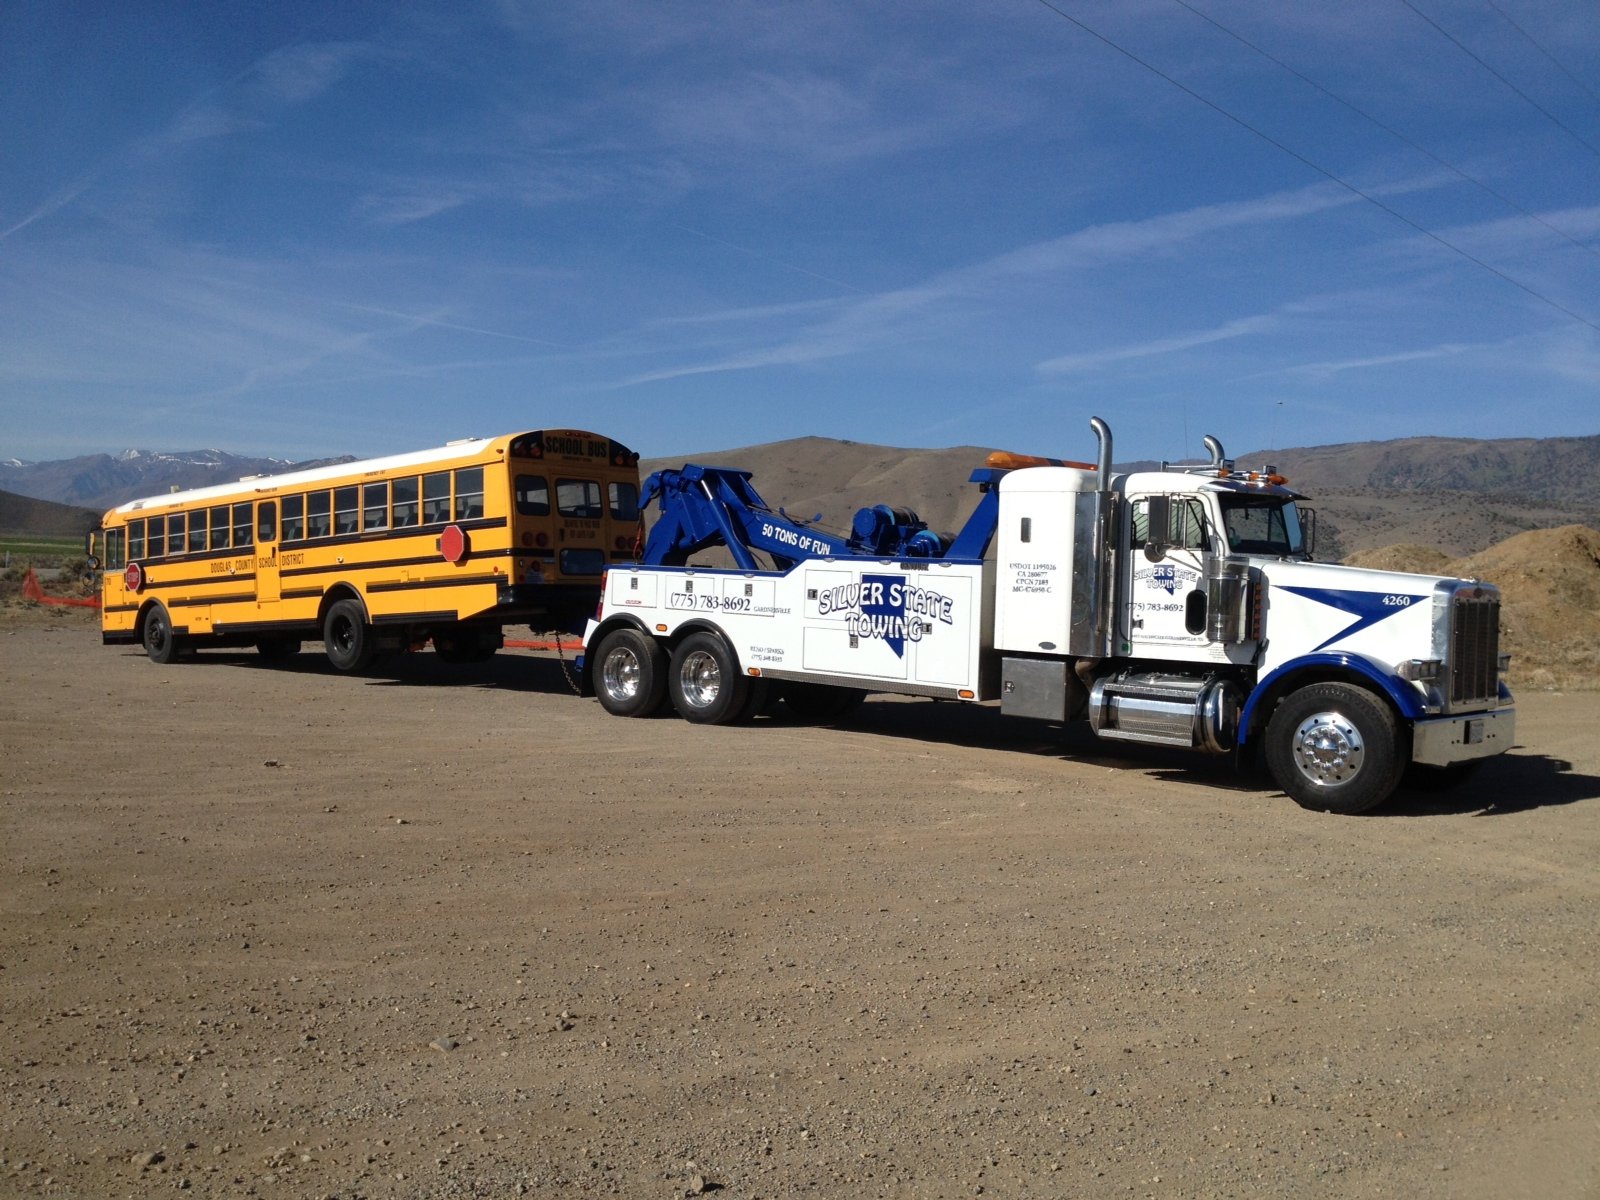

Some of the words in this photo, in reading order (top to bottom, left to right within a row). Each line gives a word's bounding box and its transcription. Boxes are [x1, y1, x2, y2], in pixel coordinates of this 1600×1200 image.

[545, 436, 584, 455] SCHOOL
[588, 440, 607, 458] BUS
[762, 524, 773, 536] 50
[775, 526, 798, 546] TONS
[799, 536, 812, 550] OF
[812, 539, 831, 555] FUN
[210, 560, 231, 573] DOUGLAS
[235, 558, 254, 571] COUNTY
[258, 556, 277, 568] SCHOOL
[281, 553, 304, 566] DISTRICT
[1134, 567, 1167, 581] SILVER
[1167, 567, 1197, 583] STATE
[1146, 579, 1183, 590] TOWING
[670, 592, 698, 609] (775)
[699, 594, 751, 611] 783-8692
[819, 582, 884, 615] SILVER
[889, 583, 954, 625] STATE
[1146, 603, 1184, 612] 783-8692
[1382, 595, 1411, 606] 4260
[845, 612, 923, 643] TOWING
